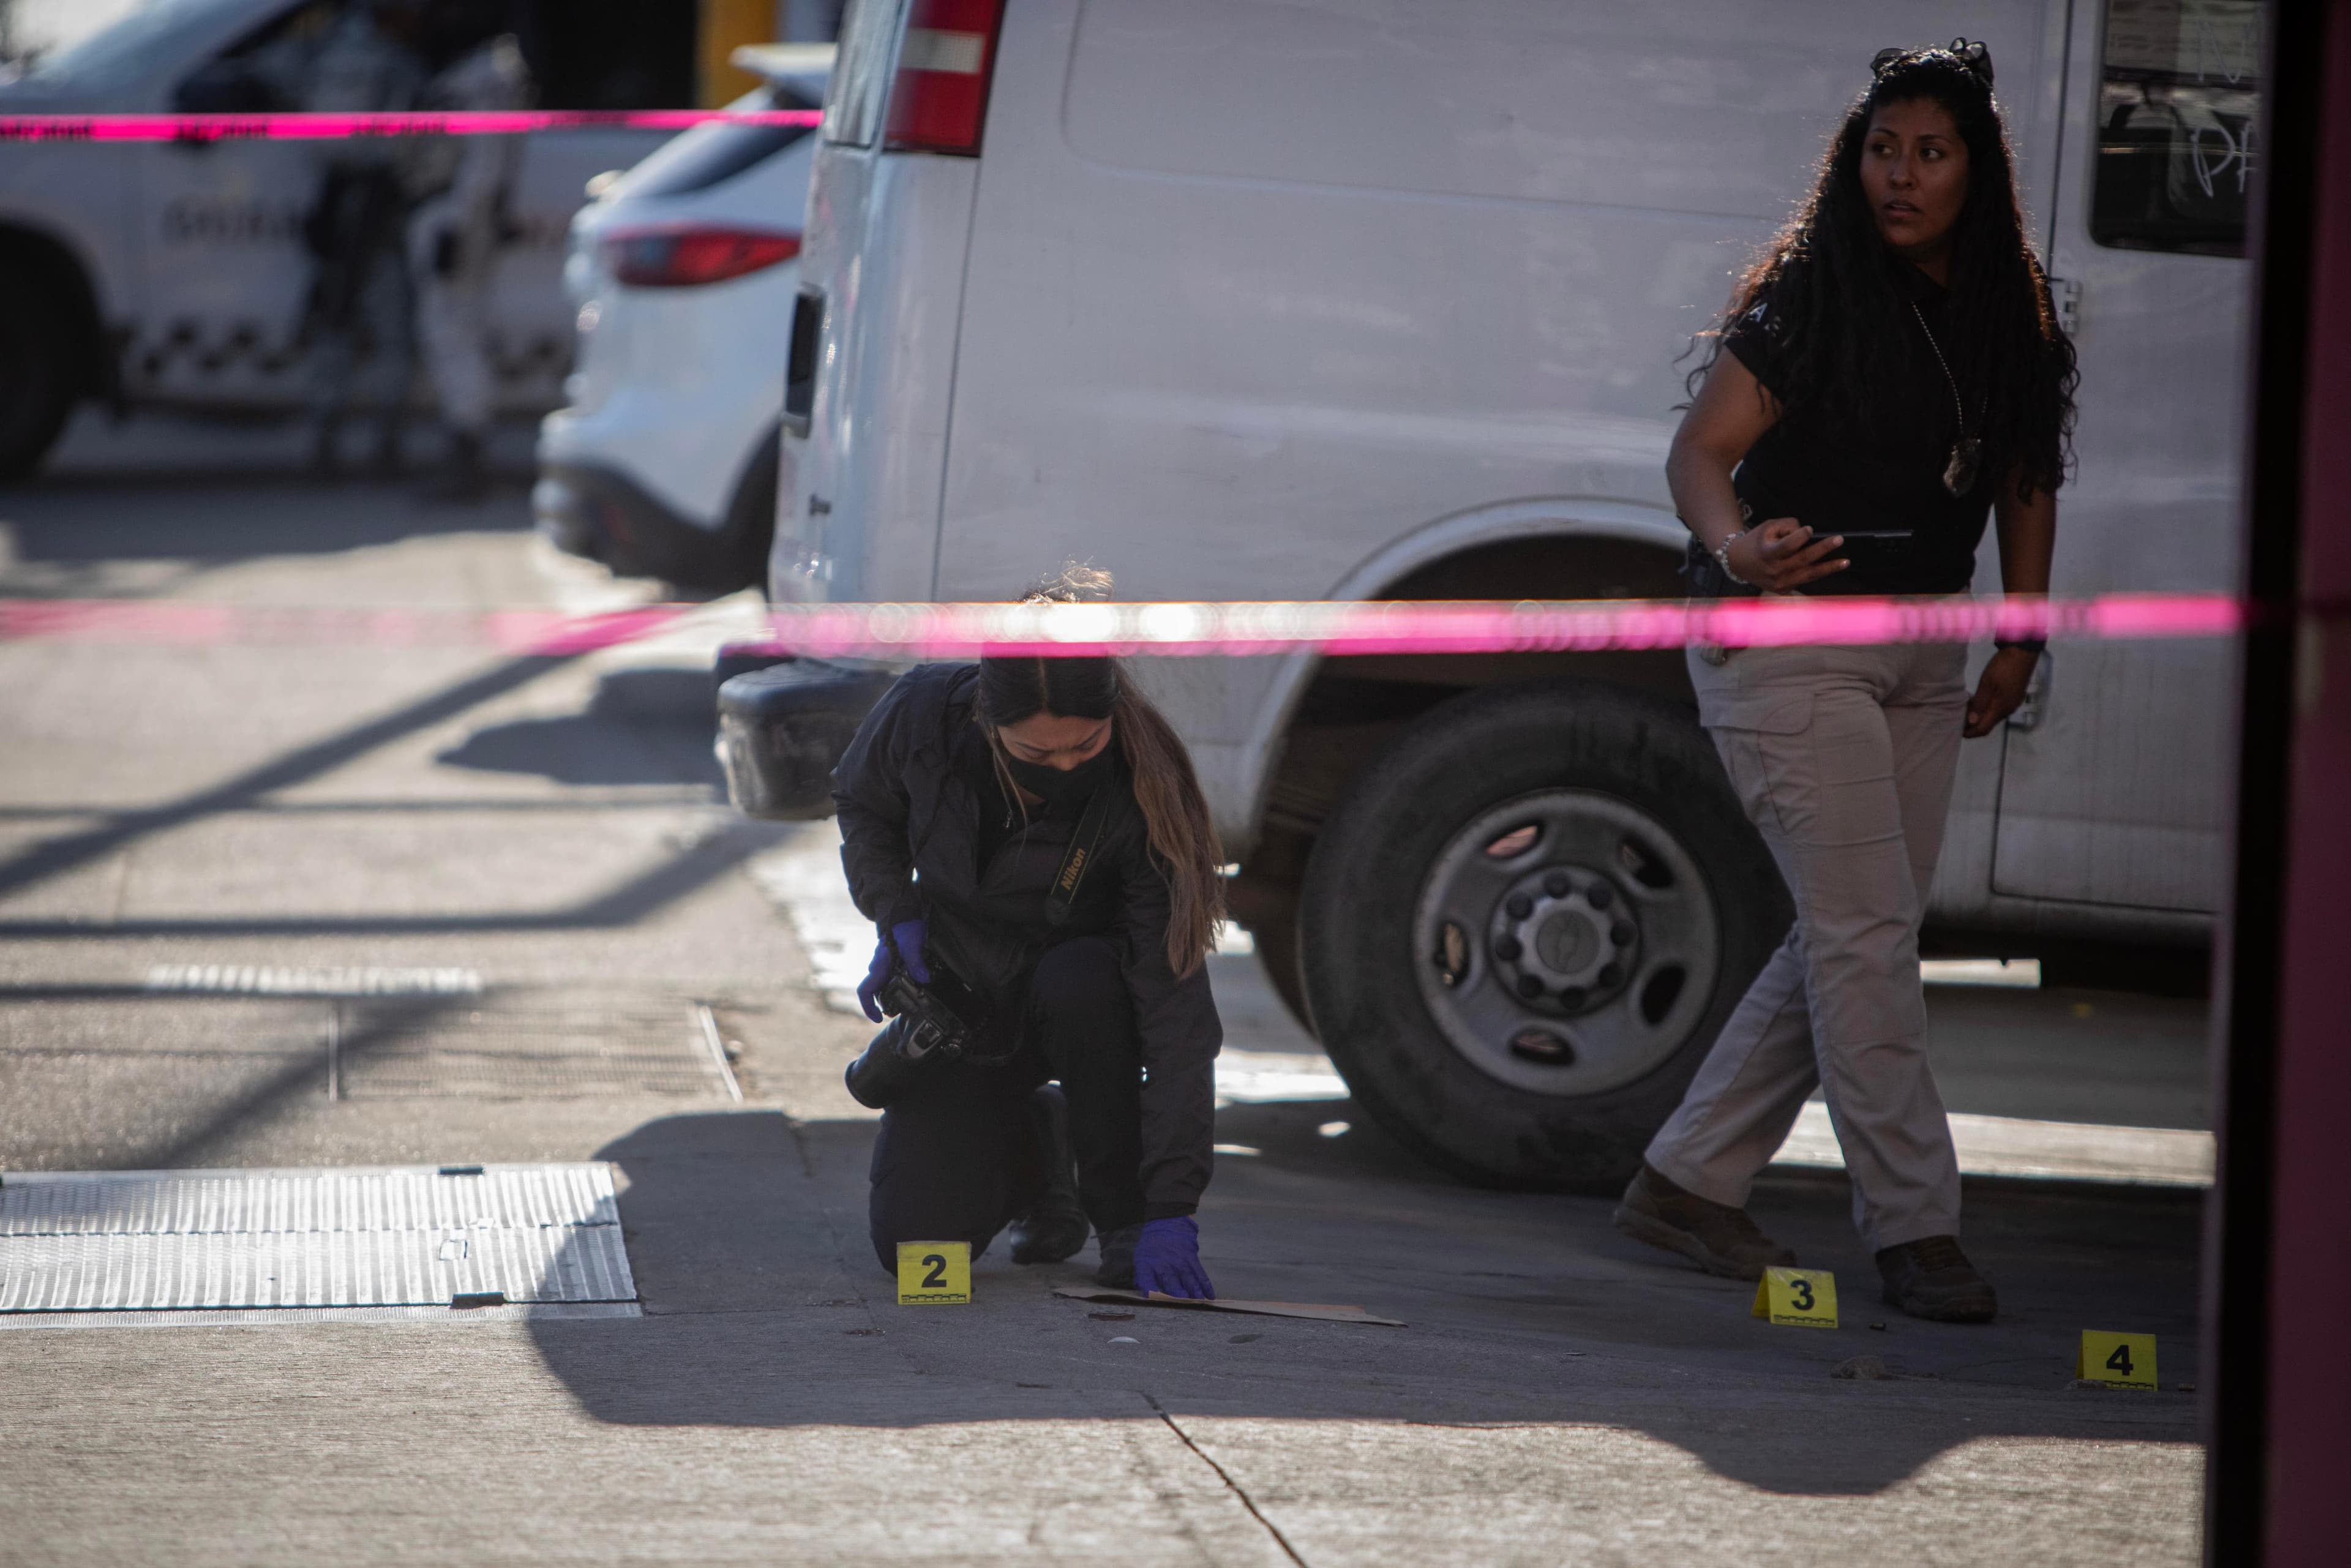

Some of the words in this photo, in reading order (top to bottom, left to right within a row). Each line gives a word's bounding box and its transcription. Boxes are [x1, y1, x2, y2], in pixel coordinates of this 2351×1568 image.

[1060, 847, 1086, 891] Nikon
[921, 1254, 947, 1288] 2
[1790, 1279, 1815, 1311] 3
[2106, 1345, 2134, 1376] 4
